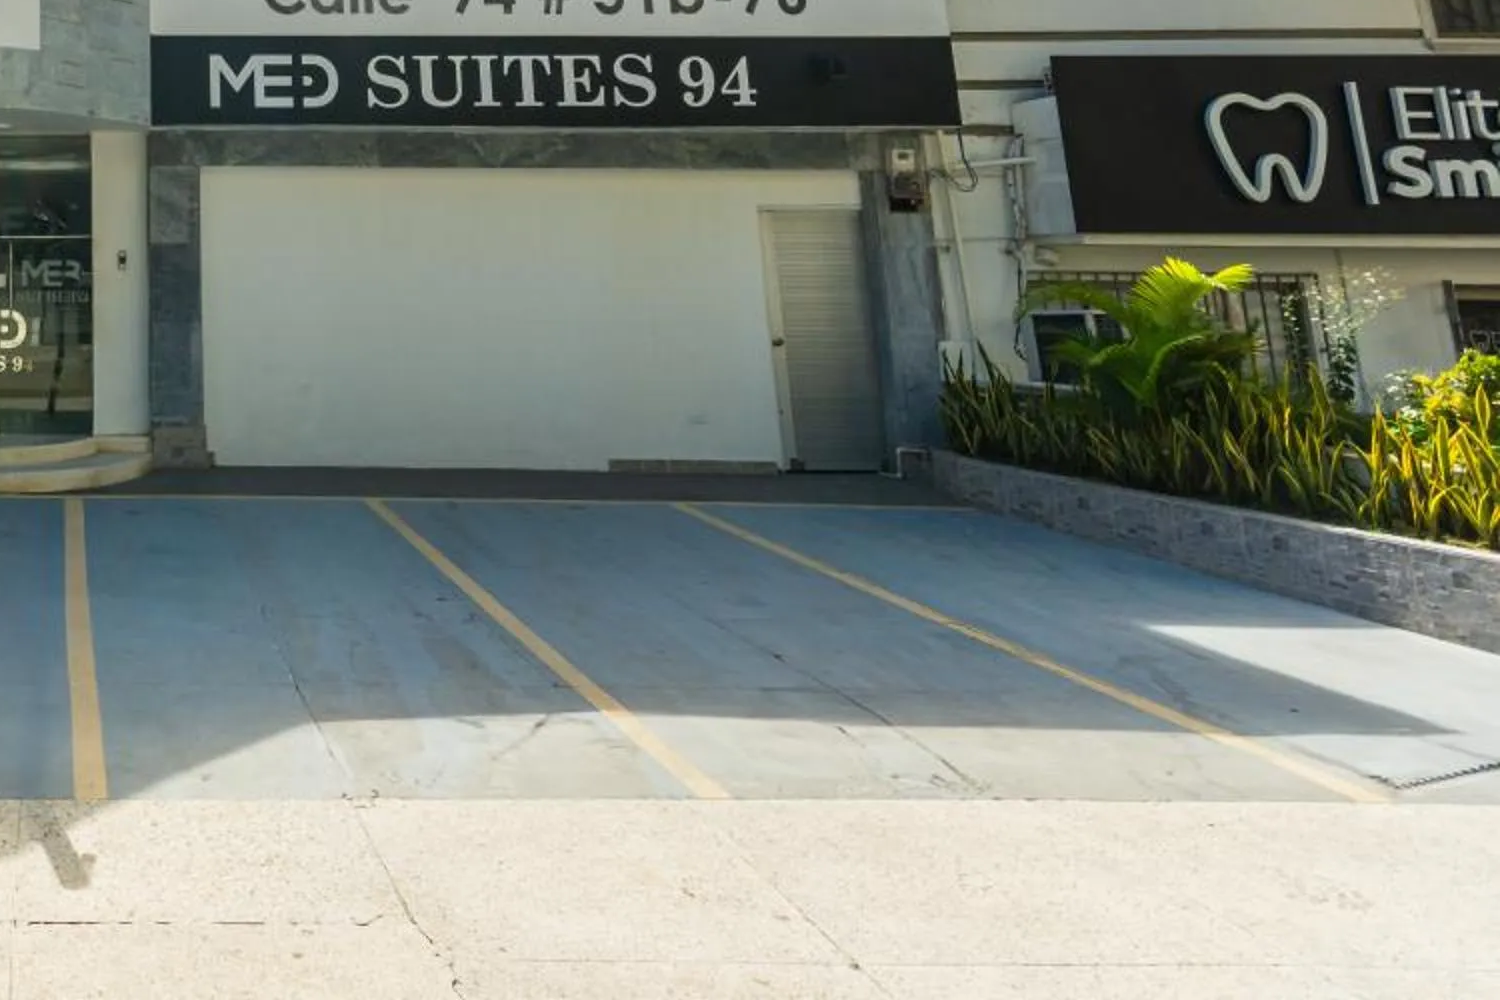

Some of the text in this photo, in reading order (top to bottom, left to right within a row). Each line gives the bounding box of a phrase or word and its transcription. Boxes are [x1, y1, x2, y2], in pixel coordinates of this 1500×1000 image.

[208, 53, 758, 109] MED SUITES 94
[1388, 85, 1500, 140] Elit
